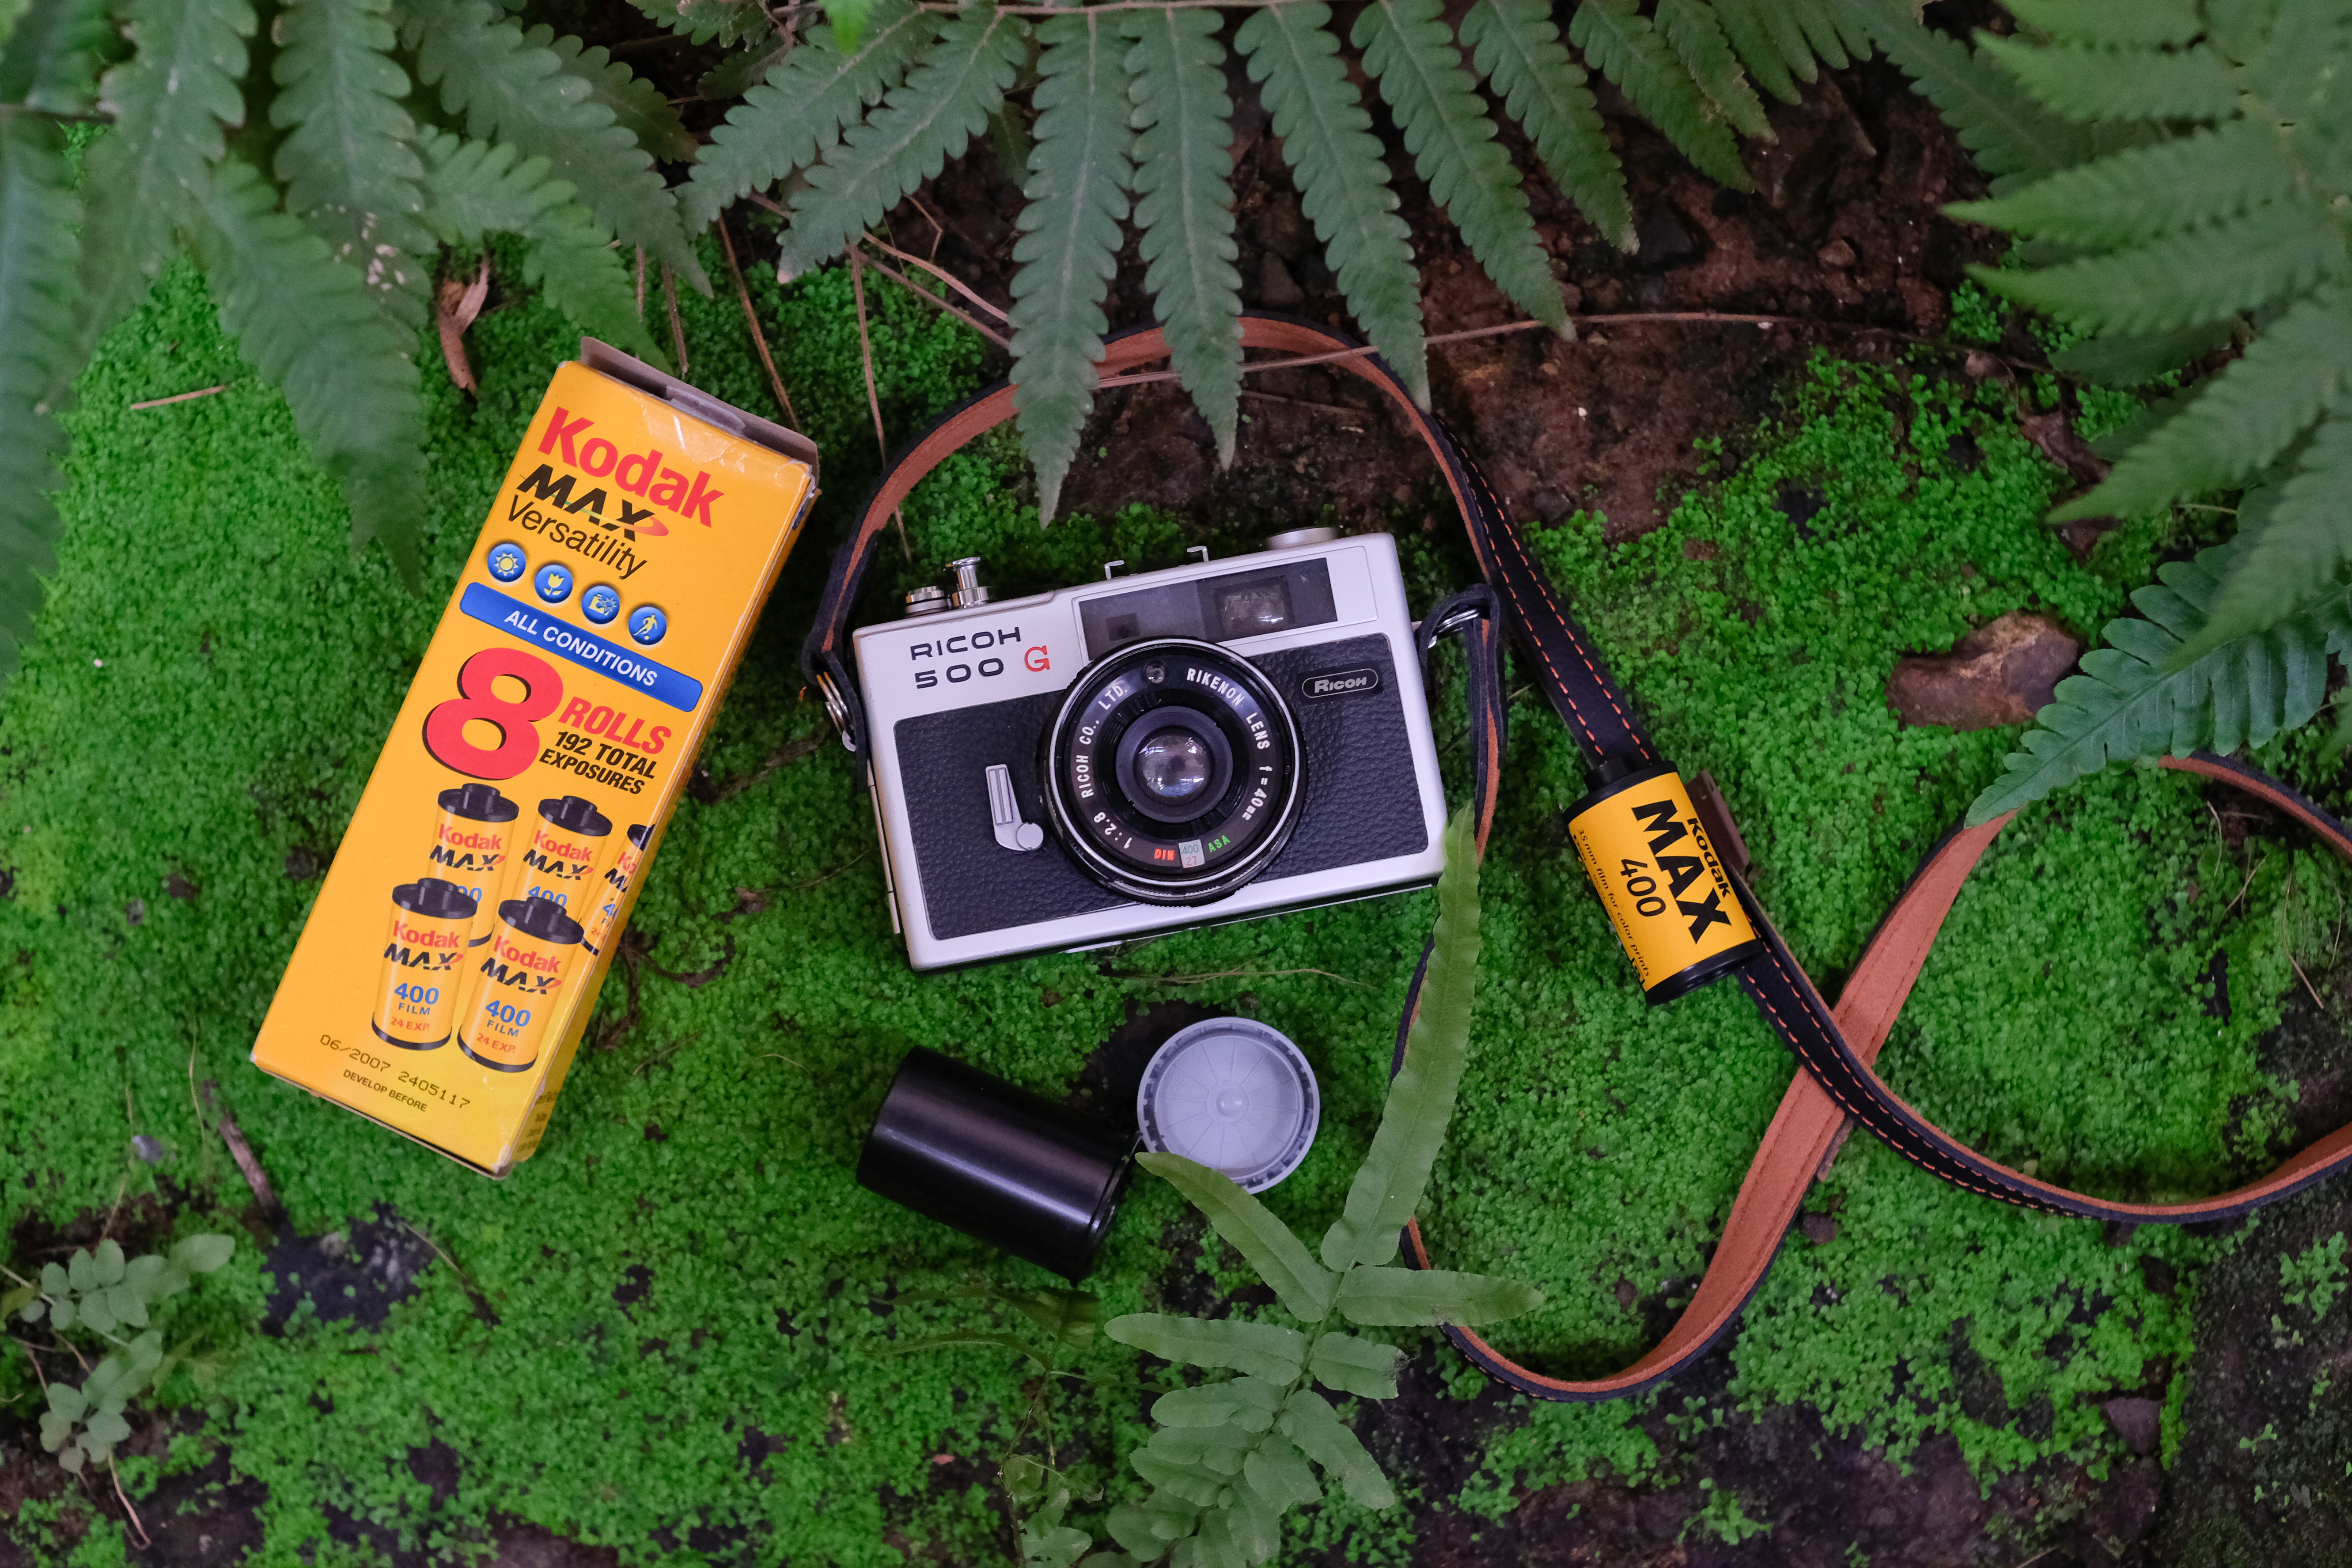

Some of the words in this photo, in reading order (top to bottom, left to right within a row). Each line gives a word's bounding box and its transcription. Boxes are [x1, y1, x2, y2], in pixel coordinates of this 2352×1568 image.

[538, 406, 724, 527] Kodak
[516, 464, 655, 542] MAX
[508, 495, 648, 579] Versatility
[504, 610, 537, 635] ALL
[543, 626, 658, 686] CONDITIONS
[910, 626, 1021, 661] RICOH
[914, 658, 1004, 689] 500
[1024, 645, 1050, 672] G
[1314, 677, 1367, 693] RICOH
[422, 647, 564, 780] 8
[558, 696, 672, 754] ROLLS
[1186, 668, 1245, 707] RIKENON
[1246, 712, 1270, 750] LENS
[555, 731, 593, 755] 192
[598, 743, 658, 779] TOTAL
[1076, 755, 1094, 799] RICOH
[1098, 686, 1128, 710] LTD.
[539, 749, 645, 795] EXPOSURES
[438, 824, 502, 850] Kodak
[533, 830, 593, 861] Kodak
[1094, 812, 1132, 849] 1:2.8
[1208, 835, 1231, 853] ASA
[429, 845, 499, 871] MAX
[523, 849, 585, 880] MAX
[1154, 848, 1175, 861] DIN
[1182, 844, 1199, 855] 400
[1186, 856, 1197, 867] 27
[1687, 818, 1731, 898] Kodak
[1620, 859, 1666, 917] 400
[1631, 799, 1732, 945] MAX
[1578, 829, 1588, 841] 35
[1585, 844, 1597, 864] mm
[1597, 868, 1609, 889] film
[1608, 893, 1618, 908] for
[1617, 913, 1633, 940] color
[1630, 944, 1649, 977] prints
[393, 920, 460, 948] Kodak
[384, 943, 458, 970] MAX
[493, 935, 561, 973] Kodak
[394, 983, 439, 1005] 400
[480, 958, 556, 994] MAX
[390, 1017, 403, 1028] 24
[406, 1021, 430, 1031] EXP.
[398, 1002, 431, 1015] FILM
[485, 1000, 531, 1027] 400
[476, 1033, 490, 1045] 24
[491, 1041, 516, 1053] EXP.
[487, 1019, 519, 1037] FILM
[320, 1034, 391, 1073] 06/2007
[398, 1071, 471, 1109] 2405117
[343, 1069, 388, 1095] DEVELOP
[389, 1089, 428, 1112] BEFORE
